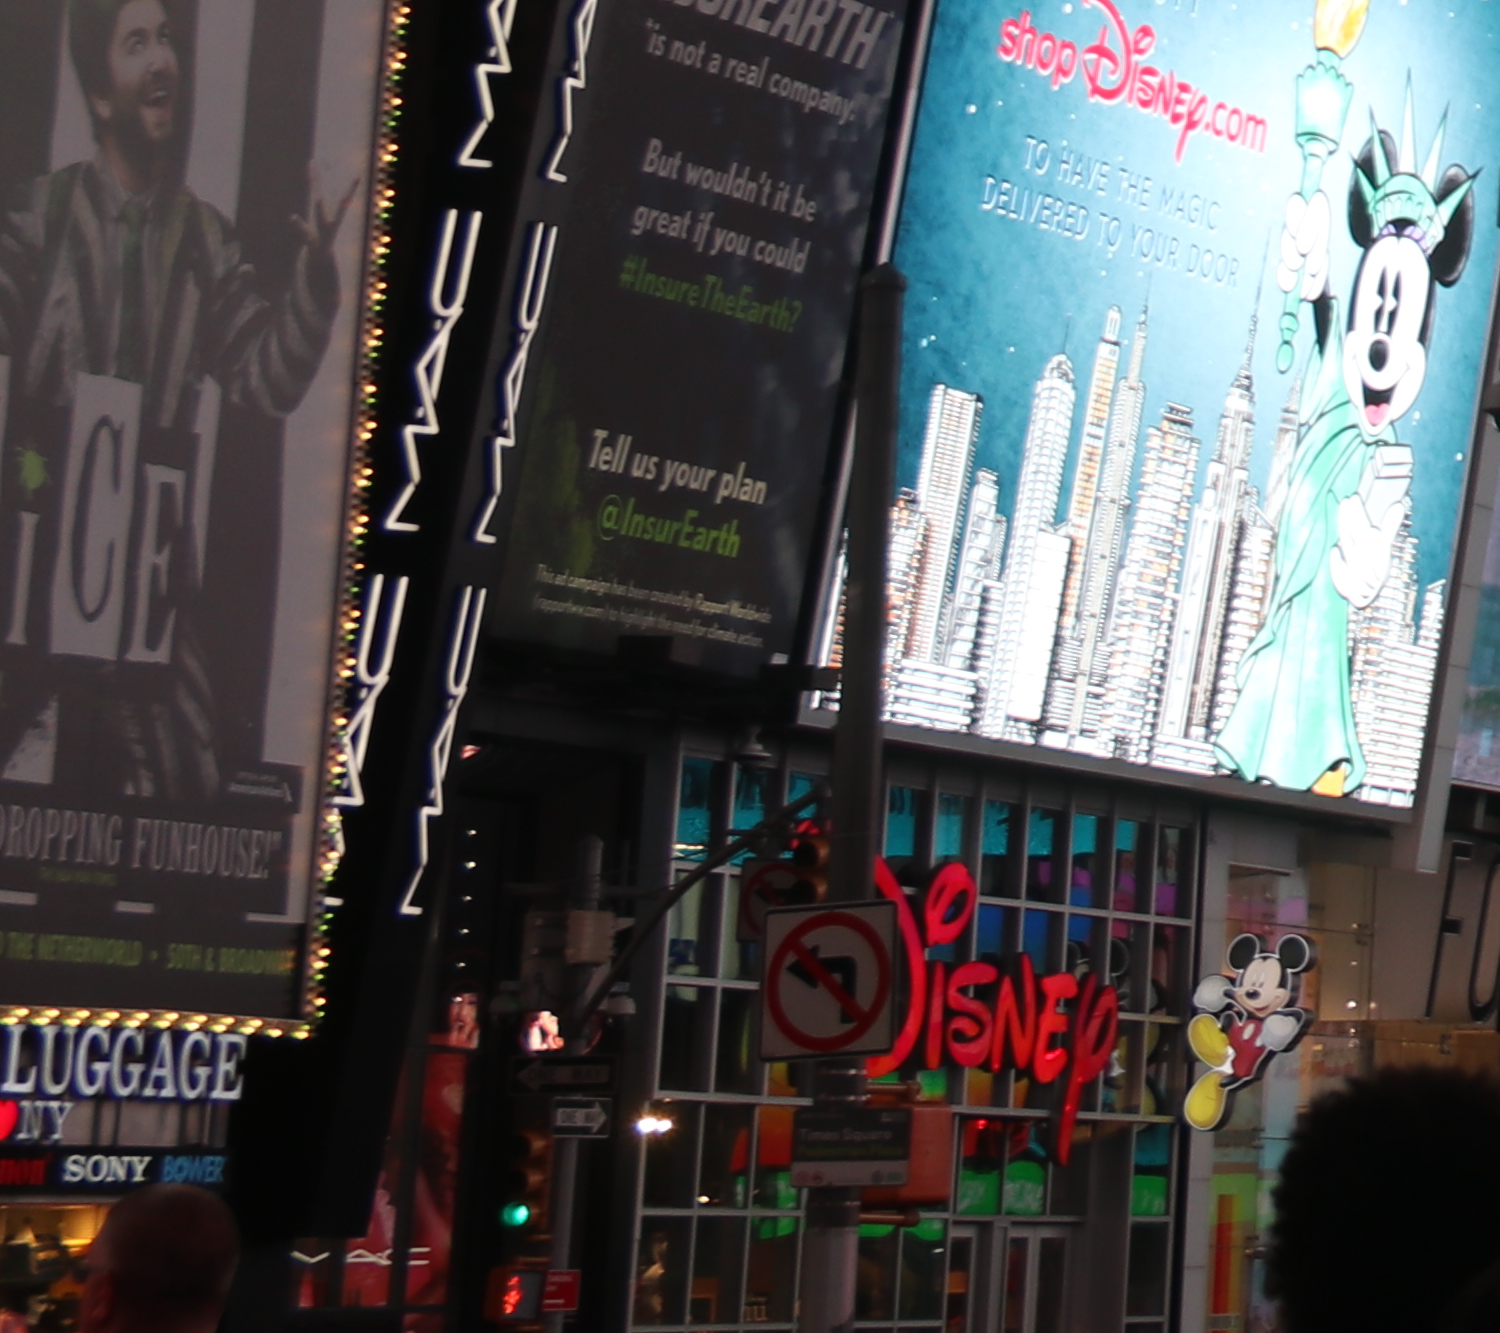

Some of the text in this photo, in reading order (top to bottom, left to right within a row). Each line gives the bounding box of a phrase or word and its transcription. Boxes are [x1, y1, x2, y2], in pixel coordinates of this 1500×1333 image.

[670, 36, 857, 126] not a real company.
[642, 137, 817, 223] But wouldn't it be
[1024, 134, 1222, 233] TO HAVE THE MAGIC
[631, 204, 812, 276] great if you could
[980, 174, 1240, 287] DELIVERED TO YOUR DOOR
[589, 428, 768, 506] Tell us your plan
[598, 493, 741, 559] @InsurEarth
[0, 803, 124, 867] ROPPING
[1, 1023, 249, 1101] LUGGAGE
[15, 1099, 75, 1141] NY
[62, 1153, 153, 1184] SONY
[161, 1154, 228, 1184] BOWER
